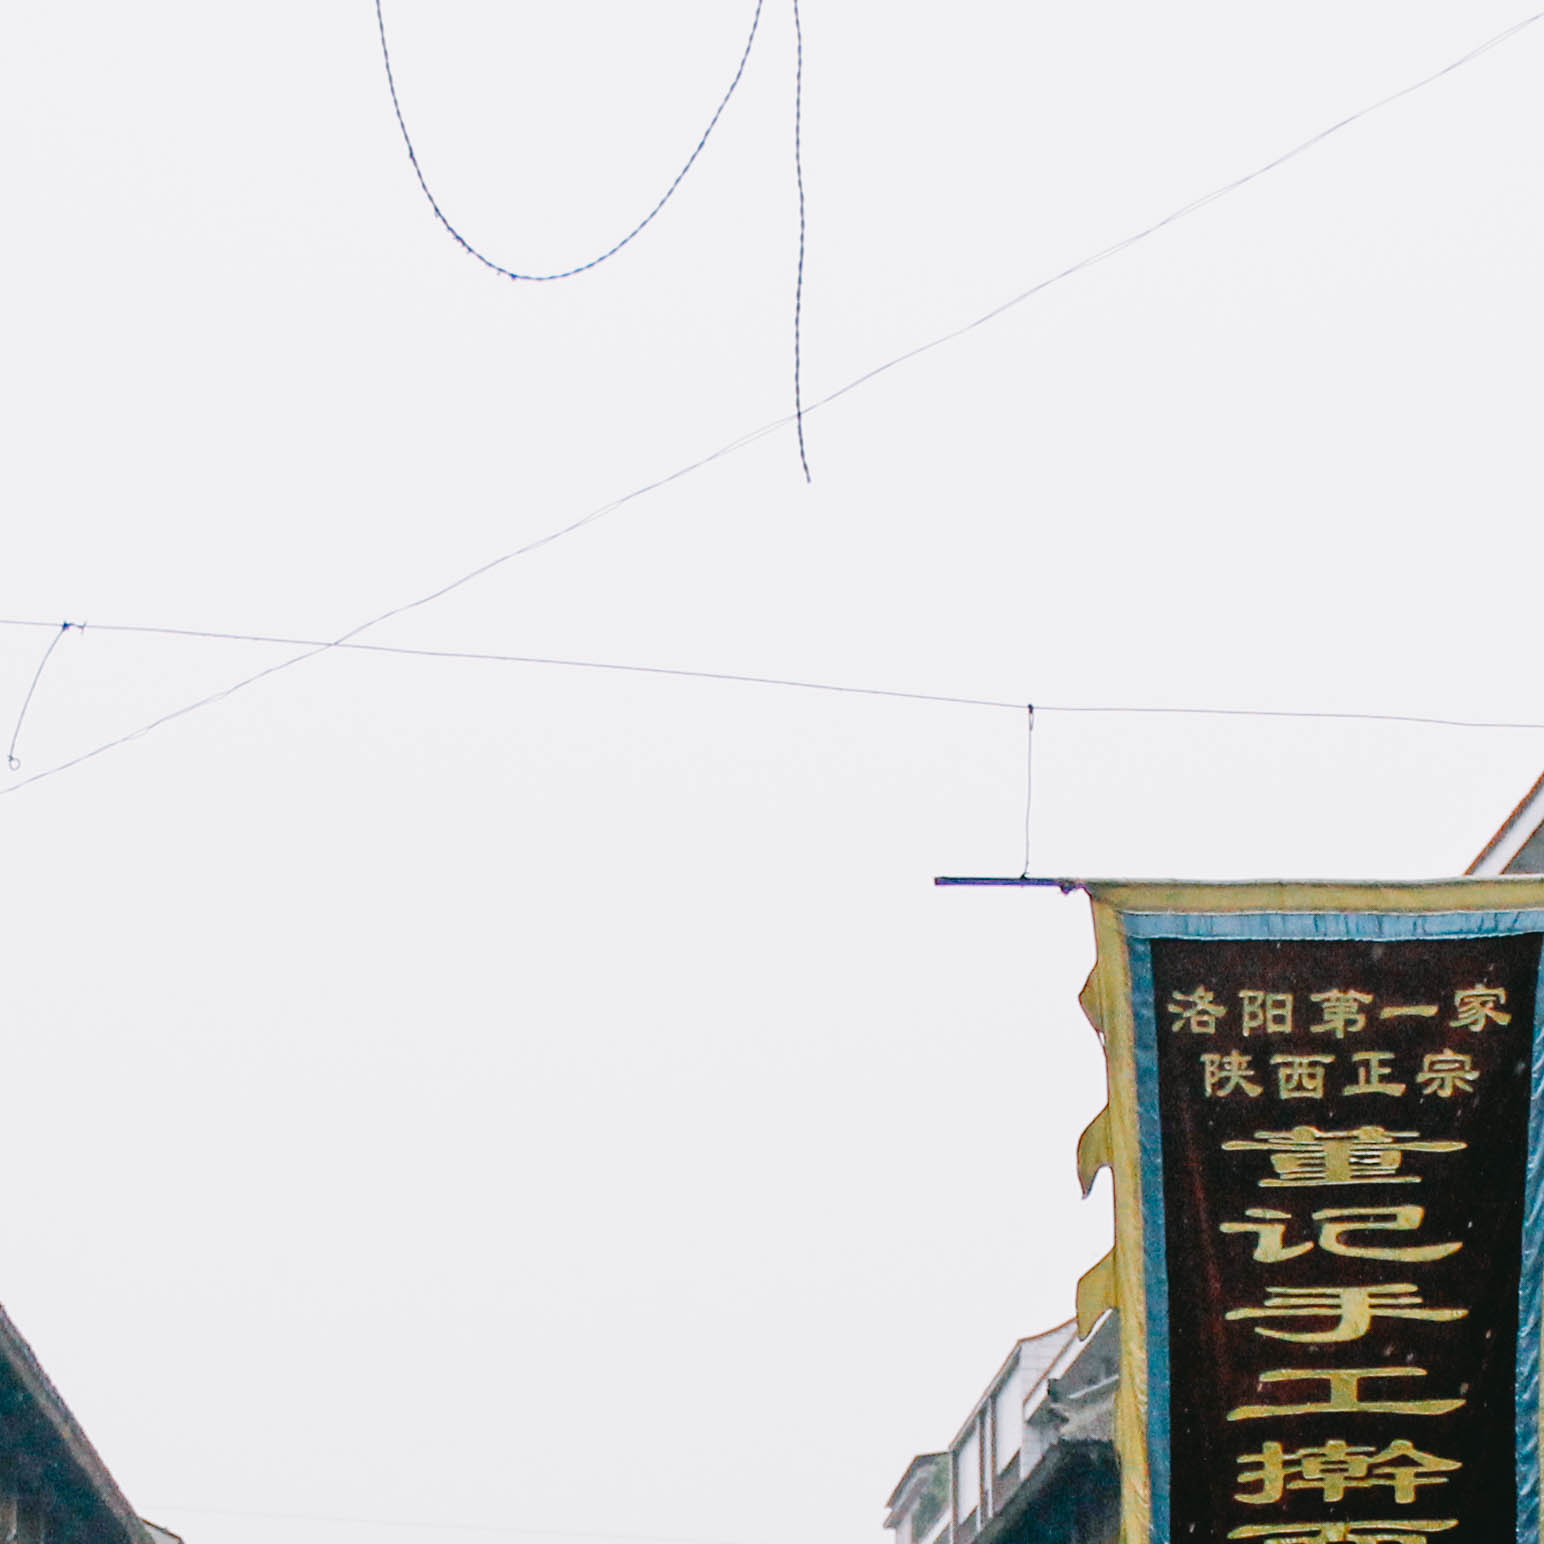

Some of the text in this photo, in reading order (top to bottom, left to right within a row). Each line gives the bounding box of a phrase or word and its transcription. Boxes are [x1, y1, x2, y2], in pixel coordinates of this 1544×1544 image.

[1167, 985, 1512, 1038] 洛阳第一家
[1200, 1049, 1480, 1099] 陕西正宗
